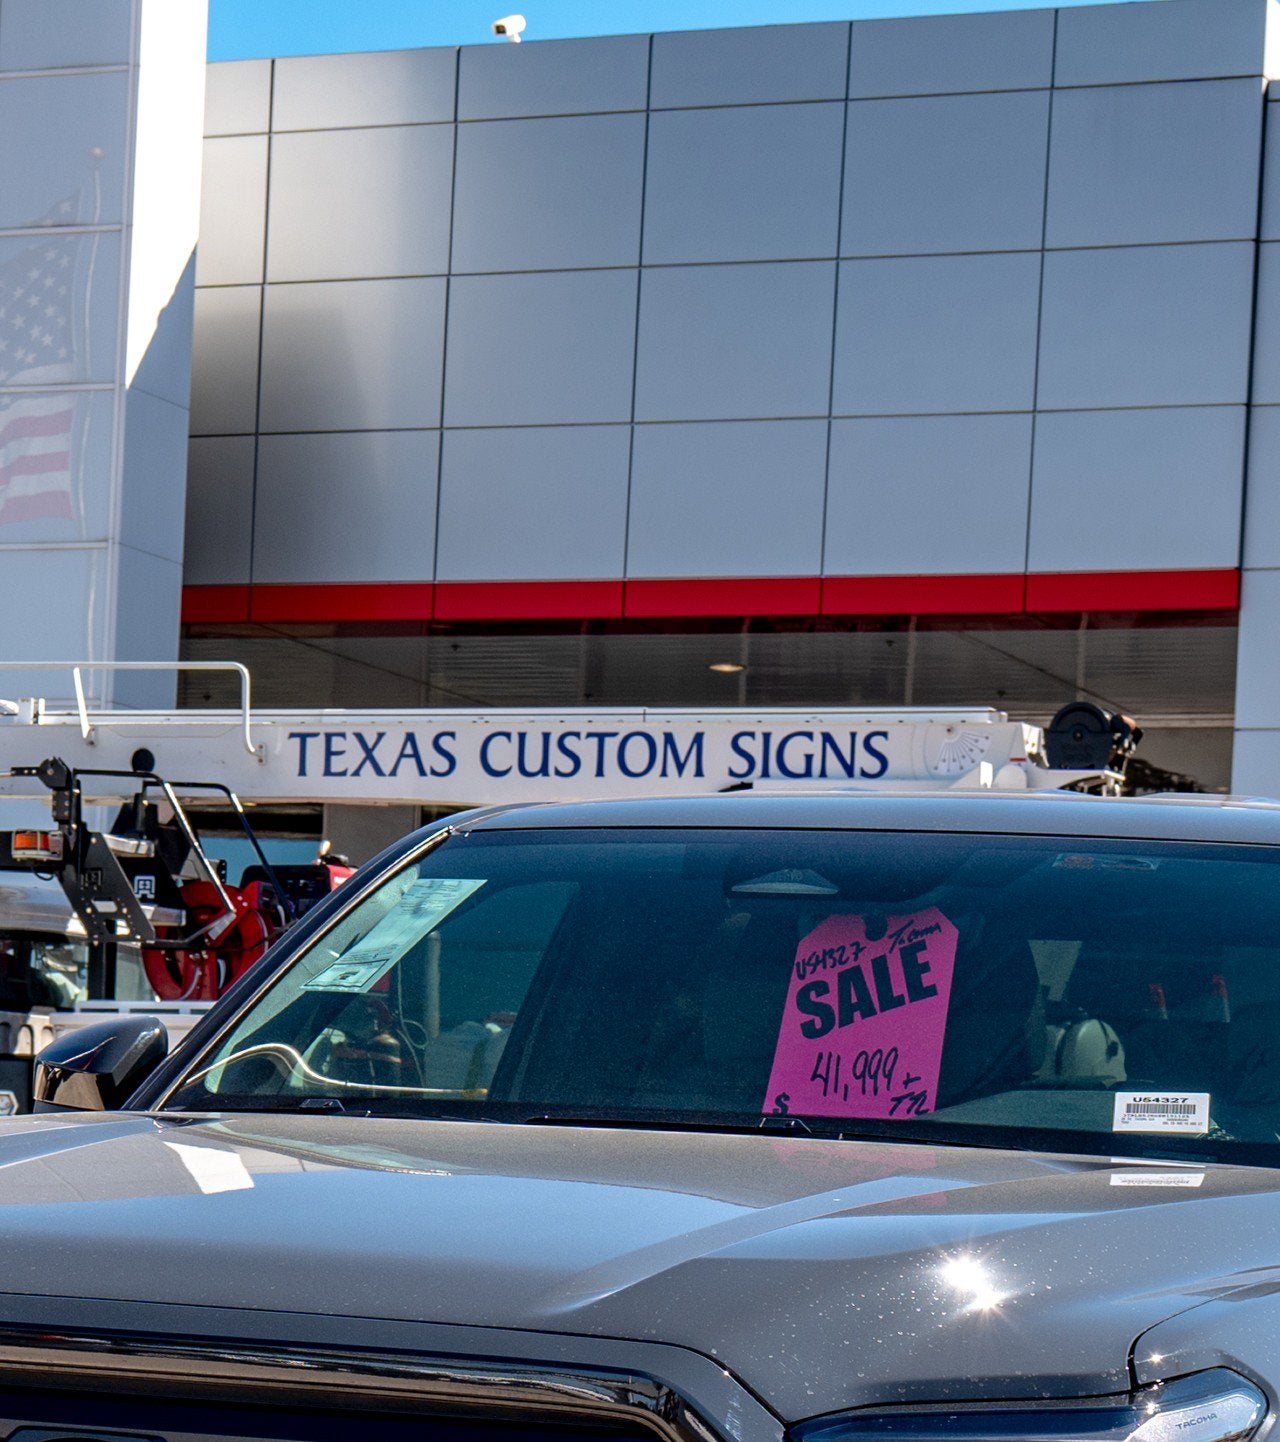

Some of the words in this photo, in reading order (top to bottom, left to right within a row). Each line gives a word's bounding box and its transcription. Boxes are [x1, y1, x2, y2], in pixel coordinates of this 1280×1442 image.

[288, 730, 458, 778] TEXAS
[478, 729, 706, 779] CUSTOM
[726, 729, 891, 779] SIGNS
[796, 939, 938, 1040] SALE
[810, 1046, 900, 1102] 41,999
